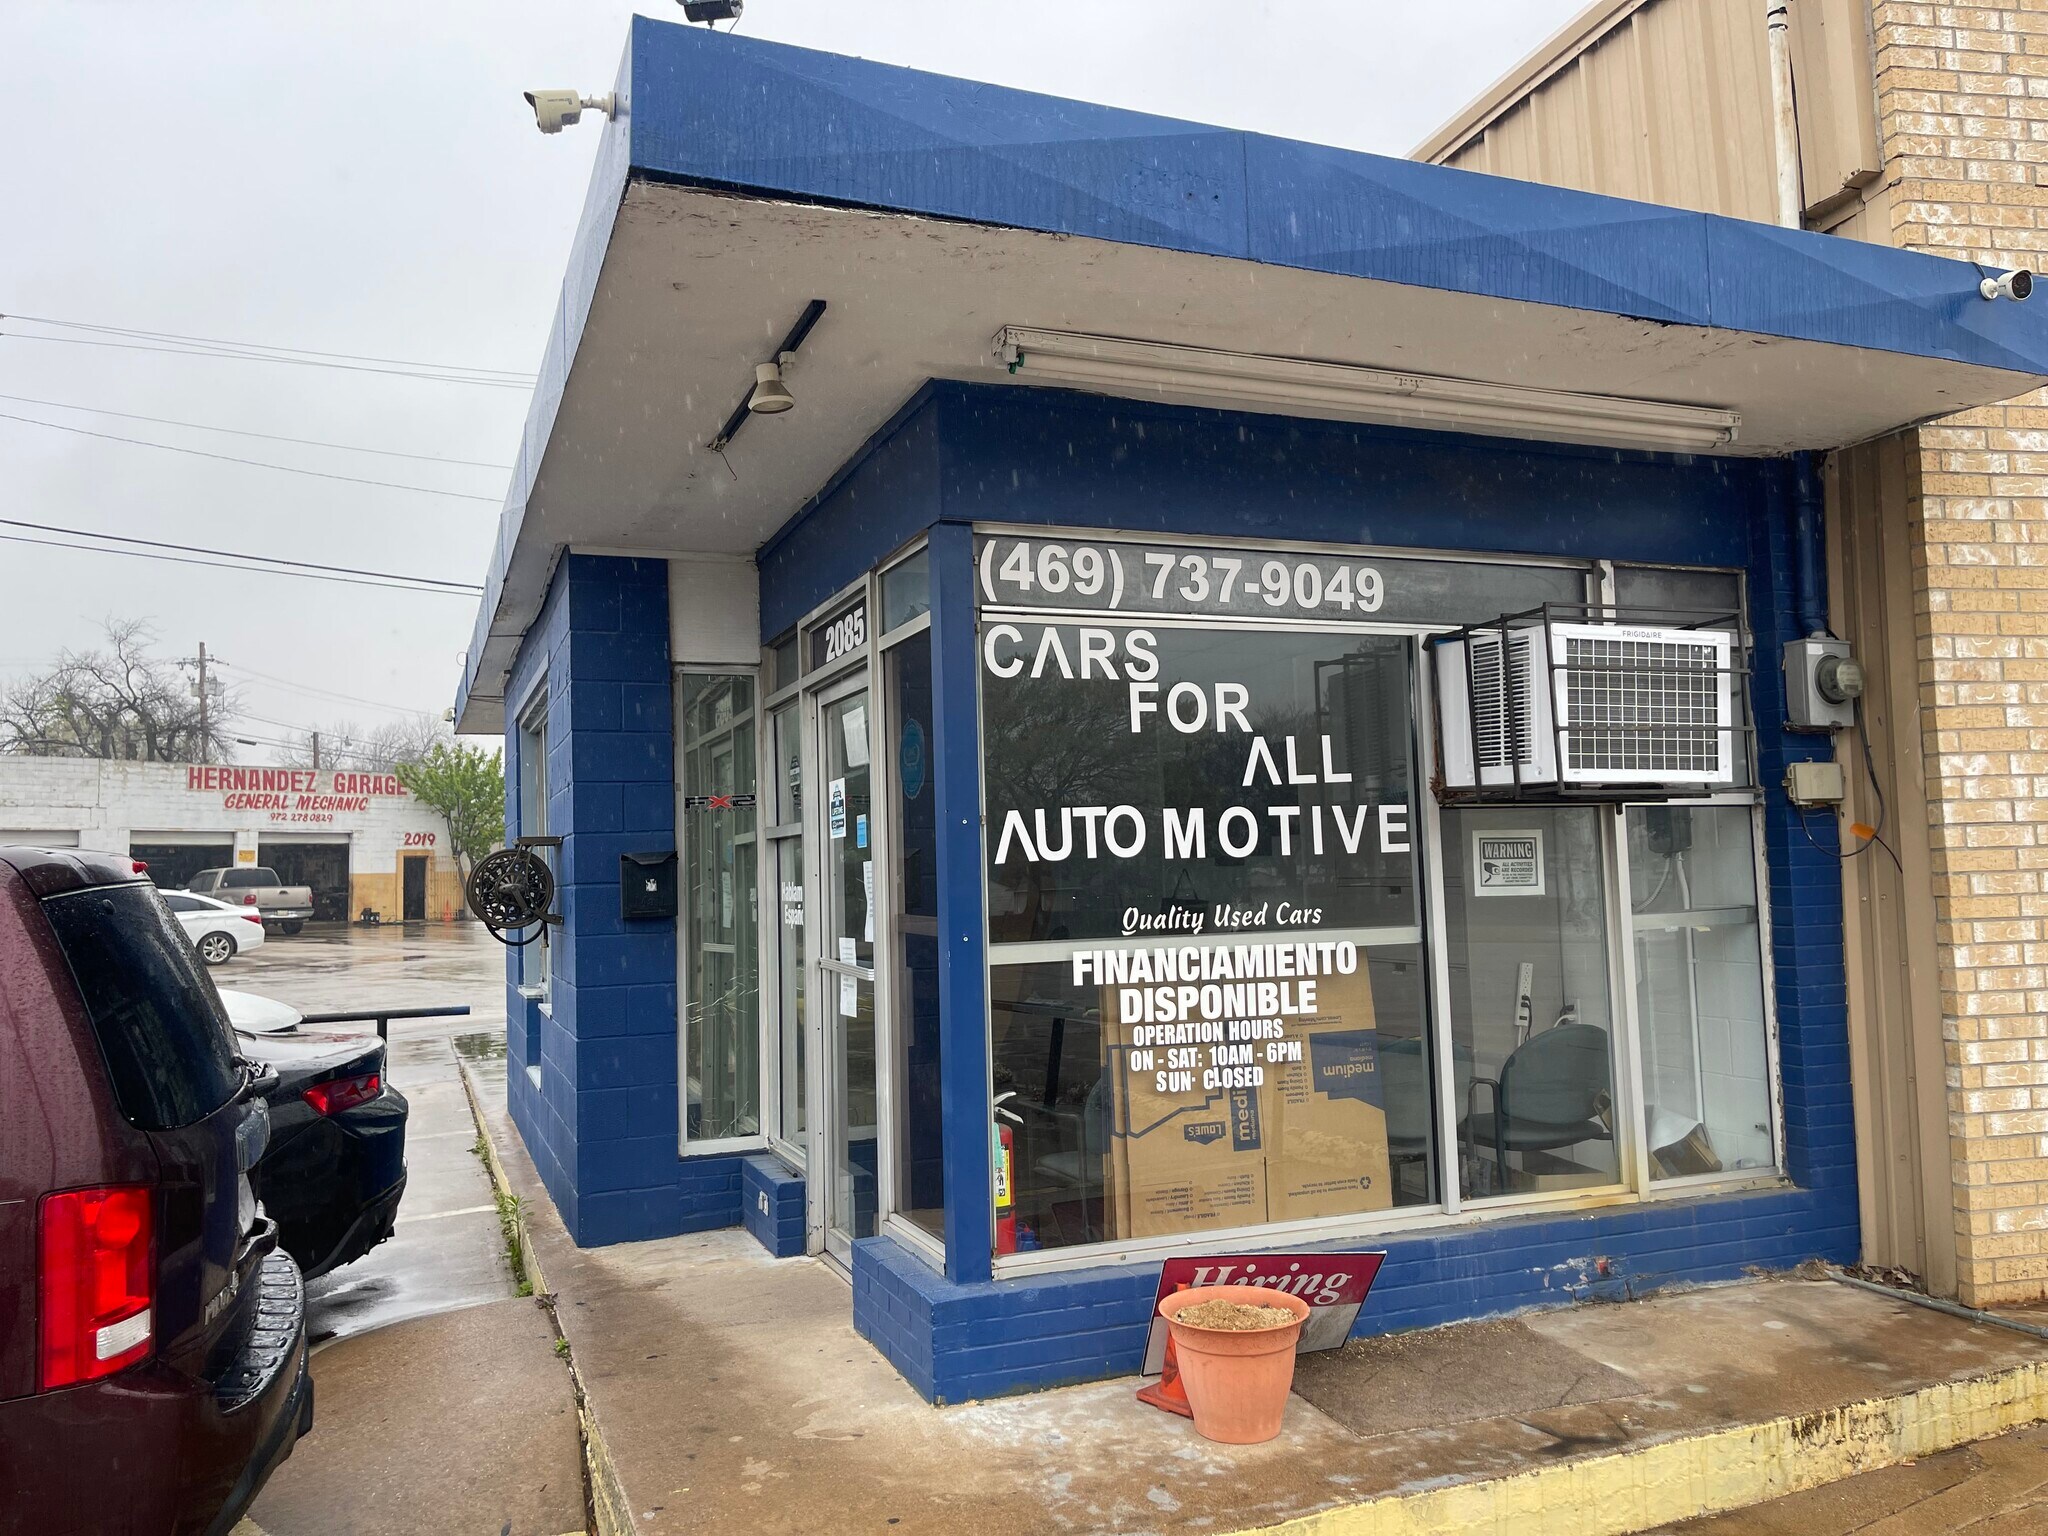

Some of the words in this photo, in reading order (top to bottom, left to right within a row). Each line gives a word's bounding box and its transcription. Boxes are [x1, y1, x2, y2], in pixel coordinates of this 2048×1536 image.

[979, 540, 1124, 609] (469)
[1144, 552, 1385, 613] 737-9049
[826, 606, 865, 663] 2085
[1622, 630, 1662, 639] FRIGIDAIRE
[984, 624, 1160, 682] CARS
[1128, 682, 1254, 734] FOR
[1242, 734, 1352, 787] ALL
[188, 766, 316, 793] HERNANDEZ
[334, 773, 407, 796] GARAGE
[224, 793, 288, 810] GENERAL
[296, 795, 368, 811] MECHANIC
[270, 812, 288, 822] 972
[404, 832, 435, 846] 2019
[1484, 843, 1532, 858] WARNING
[782, 881, 803, 902] Hablam
[1121, 904, 1204, 936] Quality
[1214, 902, 1268, 928] Used
[1275, 901, 1323, 926] Cars
[1072, 940, 1358, 987] FINANCIAMIENTO
[1119, 980, 1318, 1024] DISPONIBLE
[1132, 1021, 1224, 1047] OPERATION
[1228, 1018, 1284, 1041] HOURS
[1130, 1049, 1154, 1072] ON
[1167, 1047, 1203, 1070] SAT:
[1208, 1043, 1254, 1067] 10AM
[1266, 1041, 1302, 1064] 6PM
[1323, 1062, 1375, 1079] medium
[1203, 1066, 1264, 1090] CLOSED
[1233, 1089, 1251, 1141] medi
[1188, 1124, 1222, 1138] LOWE'S
[1190, 1263, 1352, 1306] Hiring
